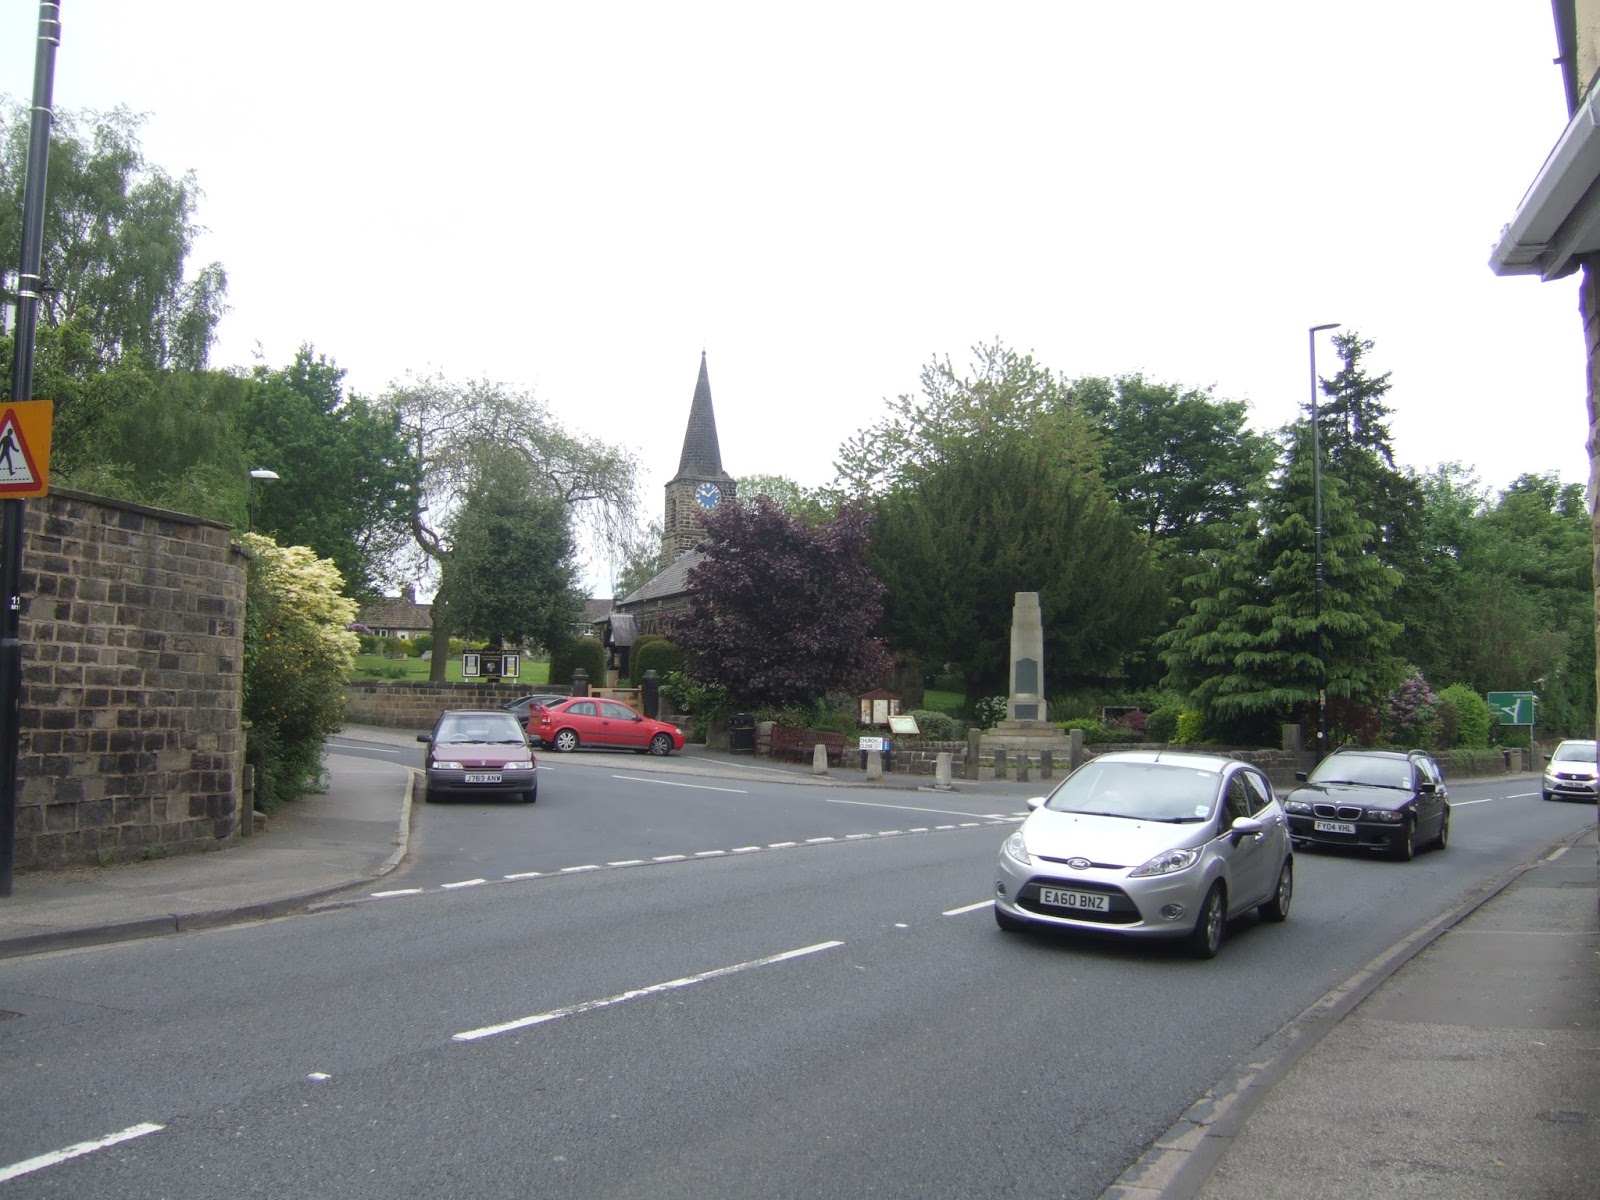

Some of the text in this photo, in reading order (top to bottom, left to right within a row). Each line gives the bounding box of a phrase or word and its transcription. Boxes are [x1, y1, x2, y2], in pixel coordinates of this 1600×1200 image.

[1317, 822, 1336, 831] FY04
[1044, 890, 1104, 910] EA60 BNZ
